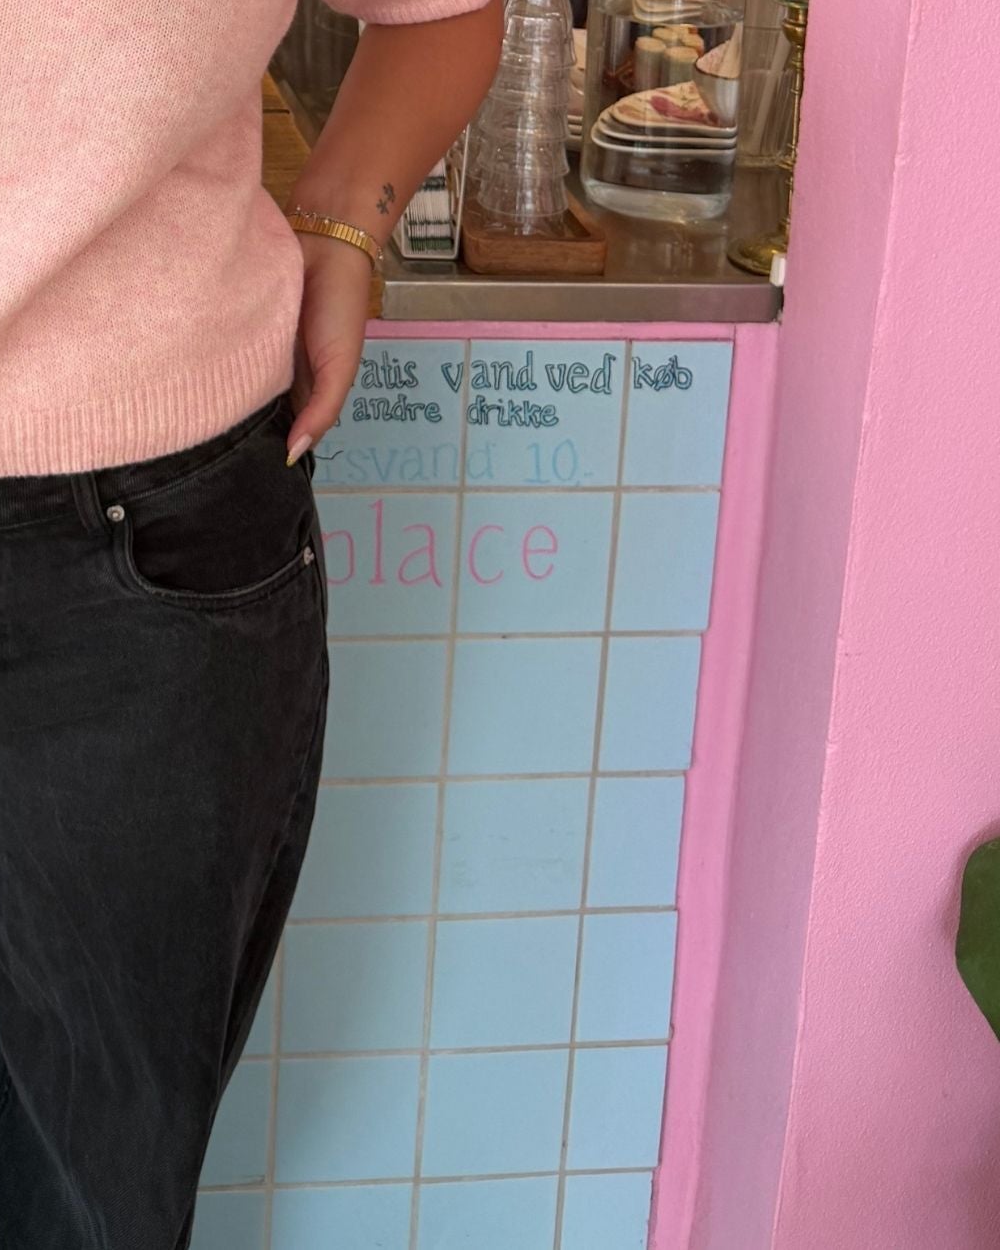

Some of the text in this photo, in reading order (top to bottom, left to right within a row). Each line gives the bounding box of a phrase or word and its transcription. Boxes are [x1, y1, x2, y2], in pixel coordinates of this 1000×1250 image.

[352, 349, 694, 395] atis vand ved køb
[352, 393, 443, 423] andre
[466, 394, 560, 429] drikke
